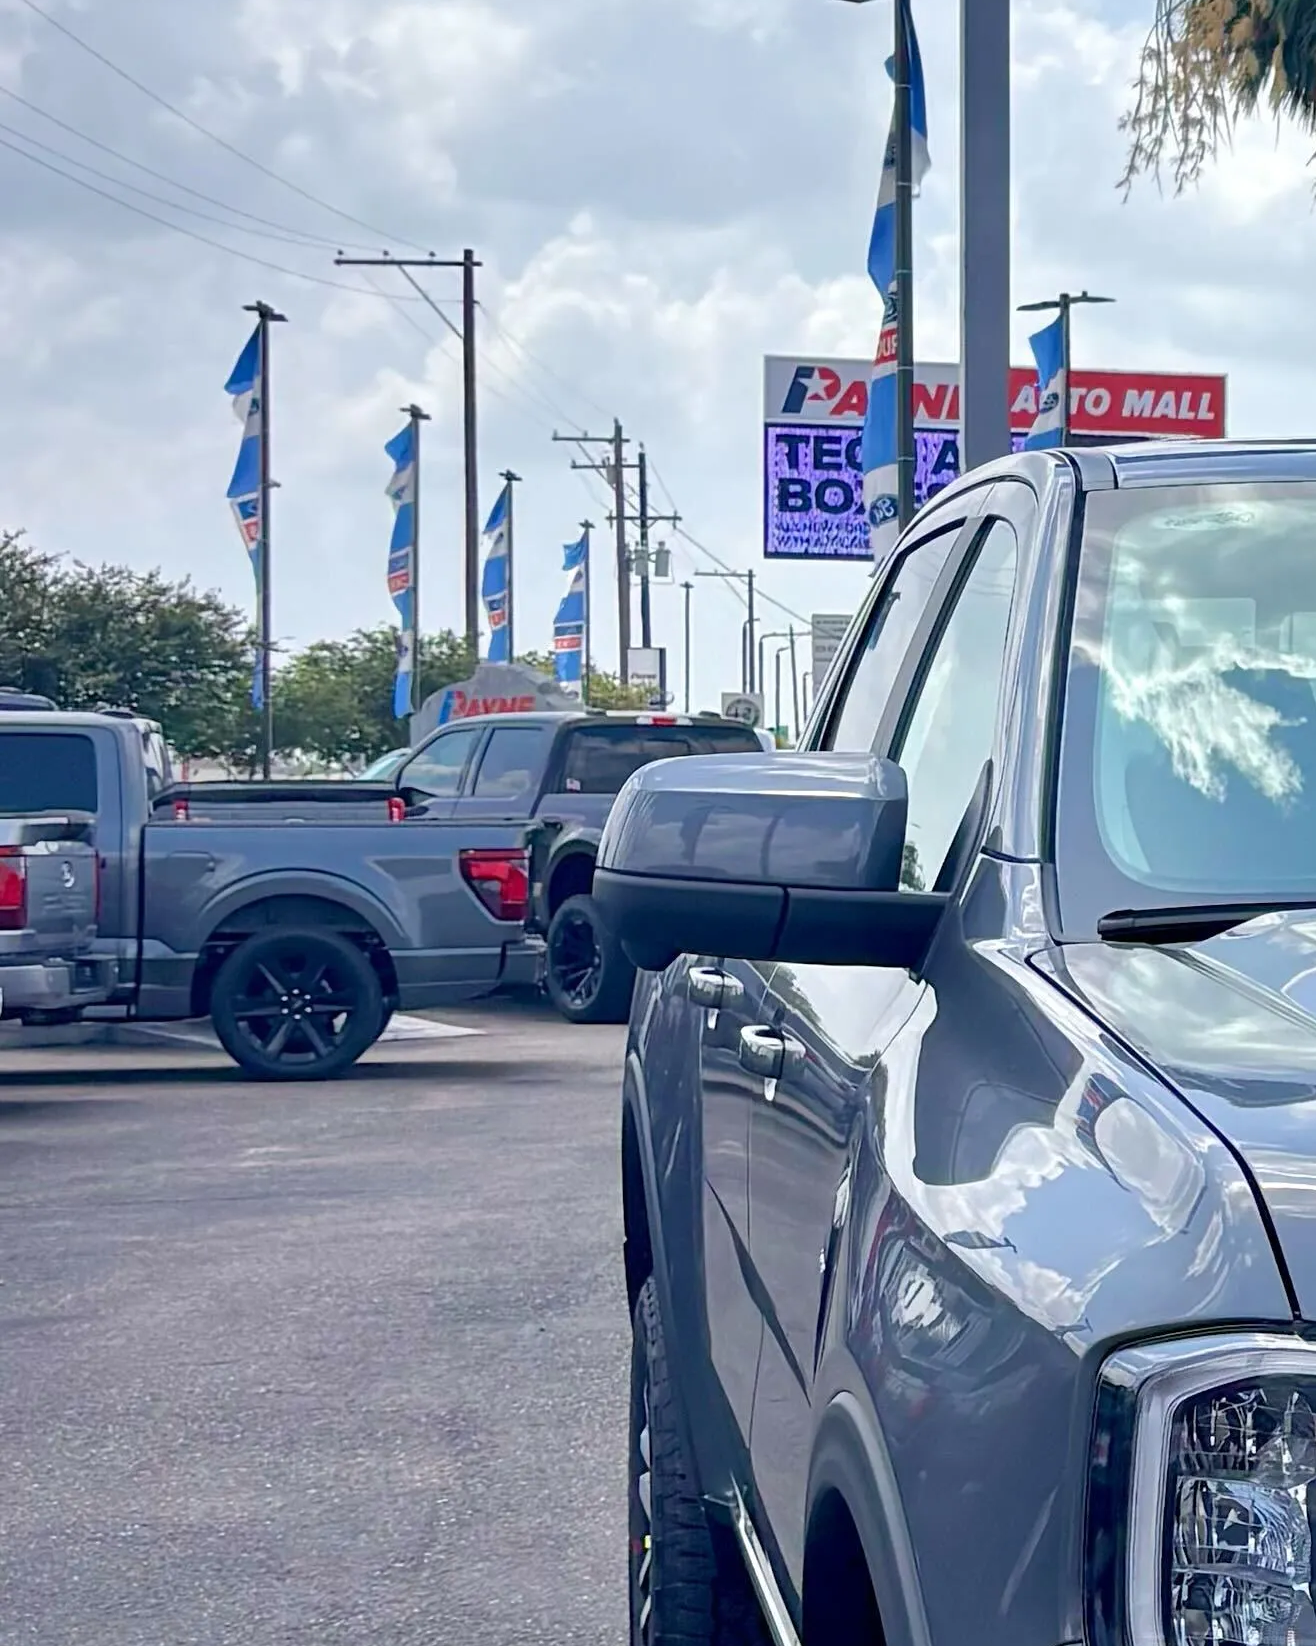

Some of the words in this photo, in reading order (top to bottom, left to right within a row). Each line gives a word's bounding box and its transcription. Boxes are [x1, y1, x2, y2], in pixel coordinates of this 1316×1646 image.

[781, 365, 960, 420] PAN
[1010, 386, 1111, 417] ATO
[1122, 388, 1215, 420] MALL
